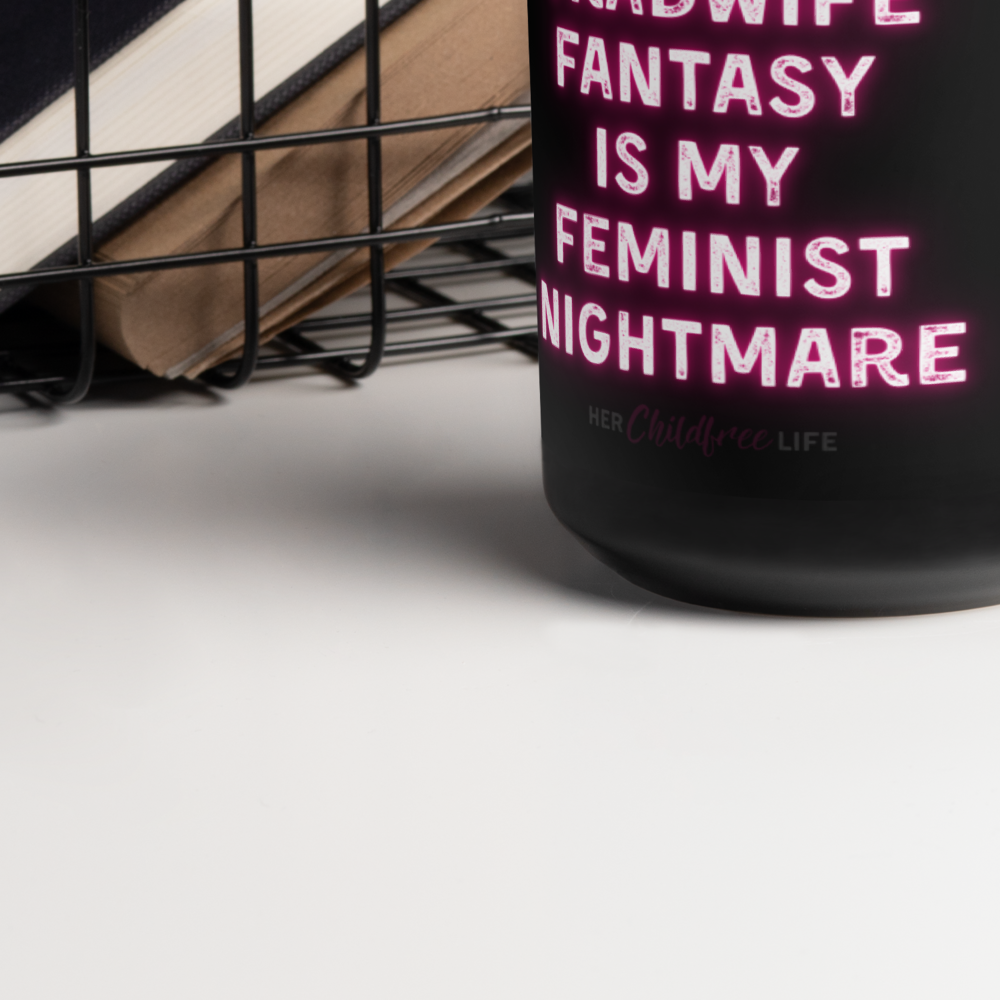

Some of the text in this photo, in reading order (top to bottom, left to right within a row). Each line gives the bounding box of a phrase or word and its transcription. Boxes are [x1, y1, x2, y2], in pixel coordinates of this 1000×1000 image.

[555, 27, 876, 118] FANTASY
[595, 128, 799, 207] IS MY
[555, 203, 910, 300] FEMINIST
[540, 280, 968, 389] NIGHTMARE
[589, 404, 837, 457] HER Childfree LIFE
